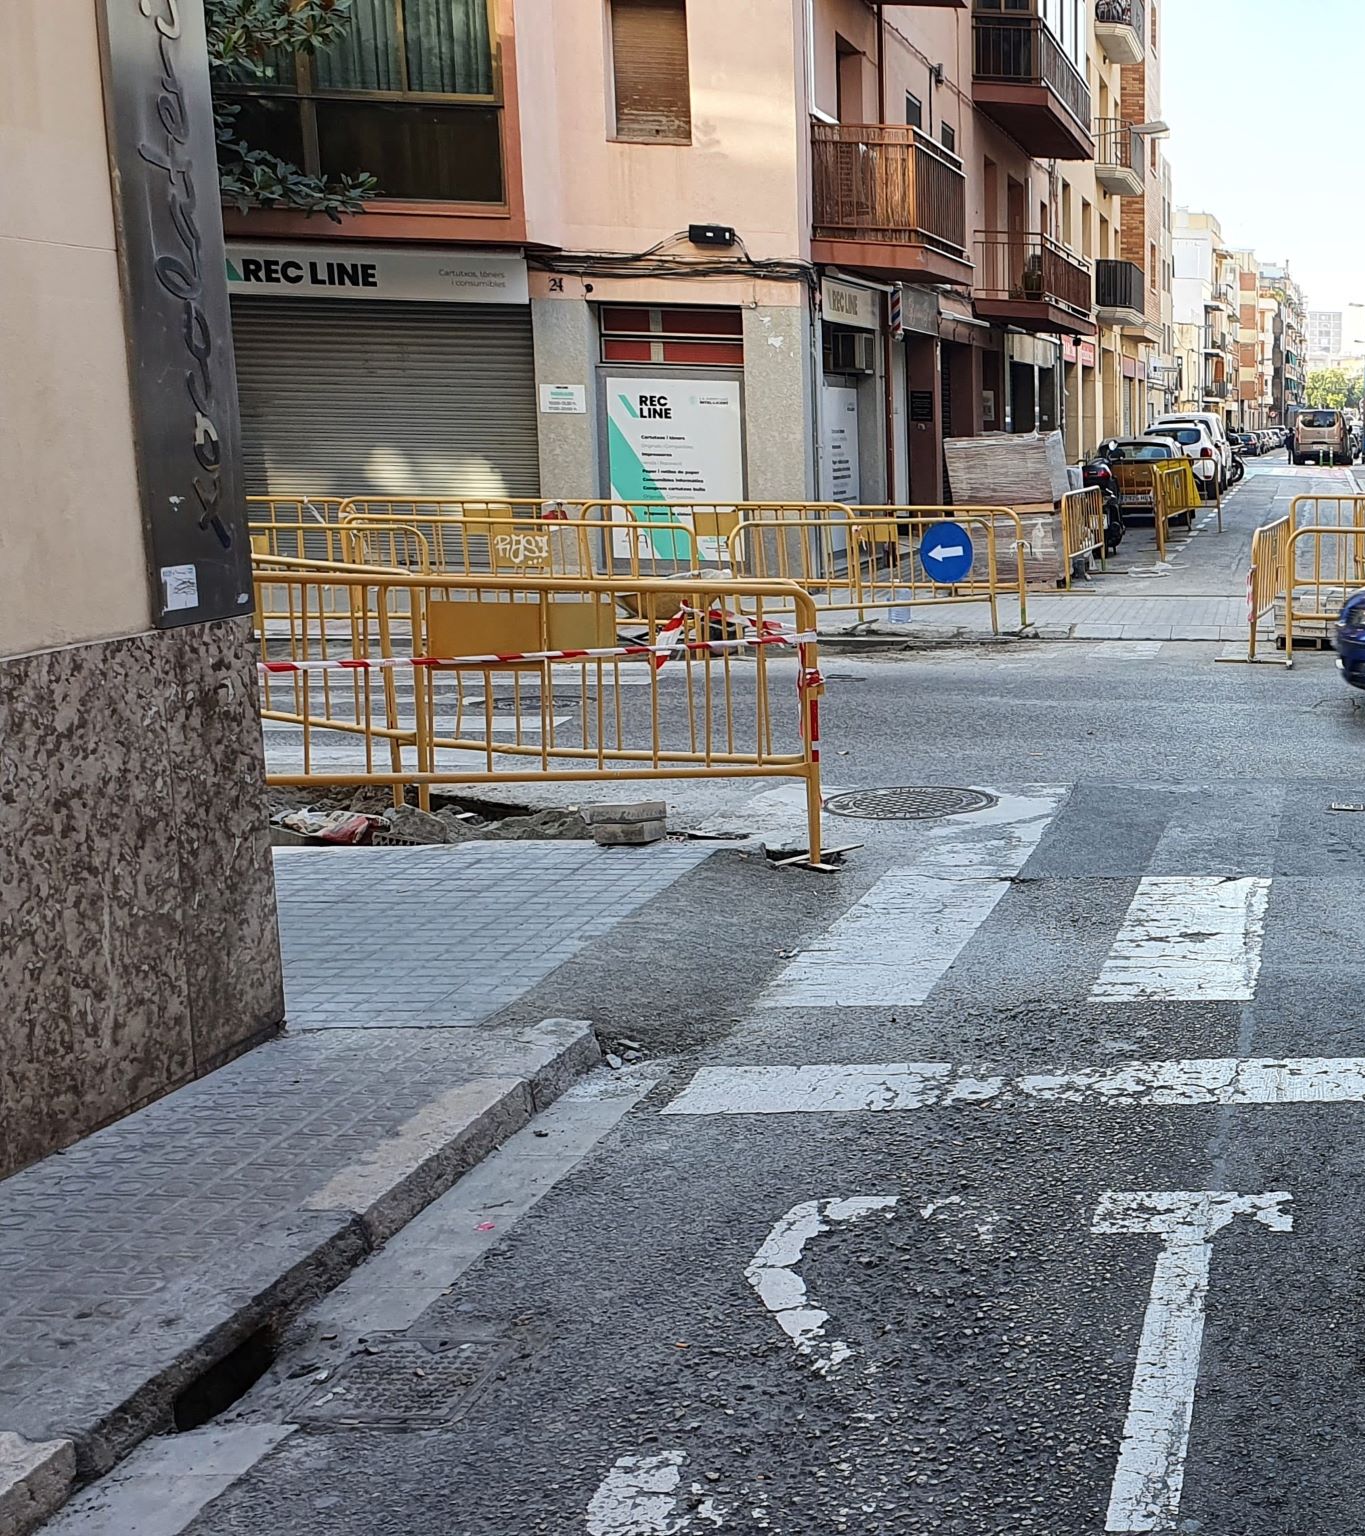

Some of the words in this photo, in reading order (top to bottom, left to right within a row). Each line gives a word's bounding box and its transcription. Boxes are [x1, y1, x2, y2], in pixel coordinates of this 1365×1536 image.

[242, 258, 303, 283] REC
[309, 261, 378, 288] LINE
[639, 395, 668, 407] REC
[639, 407, 672, 419] LINE
